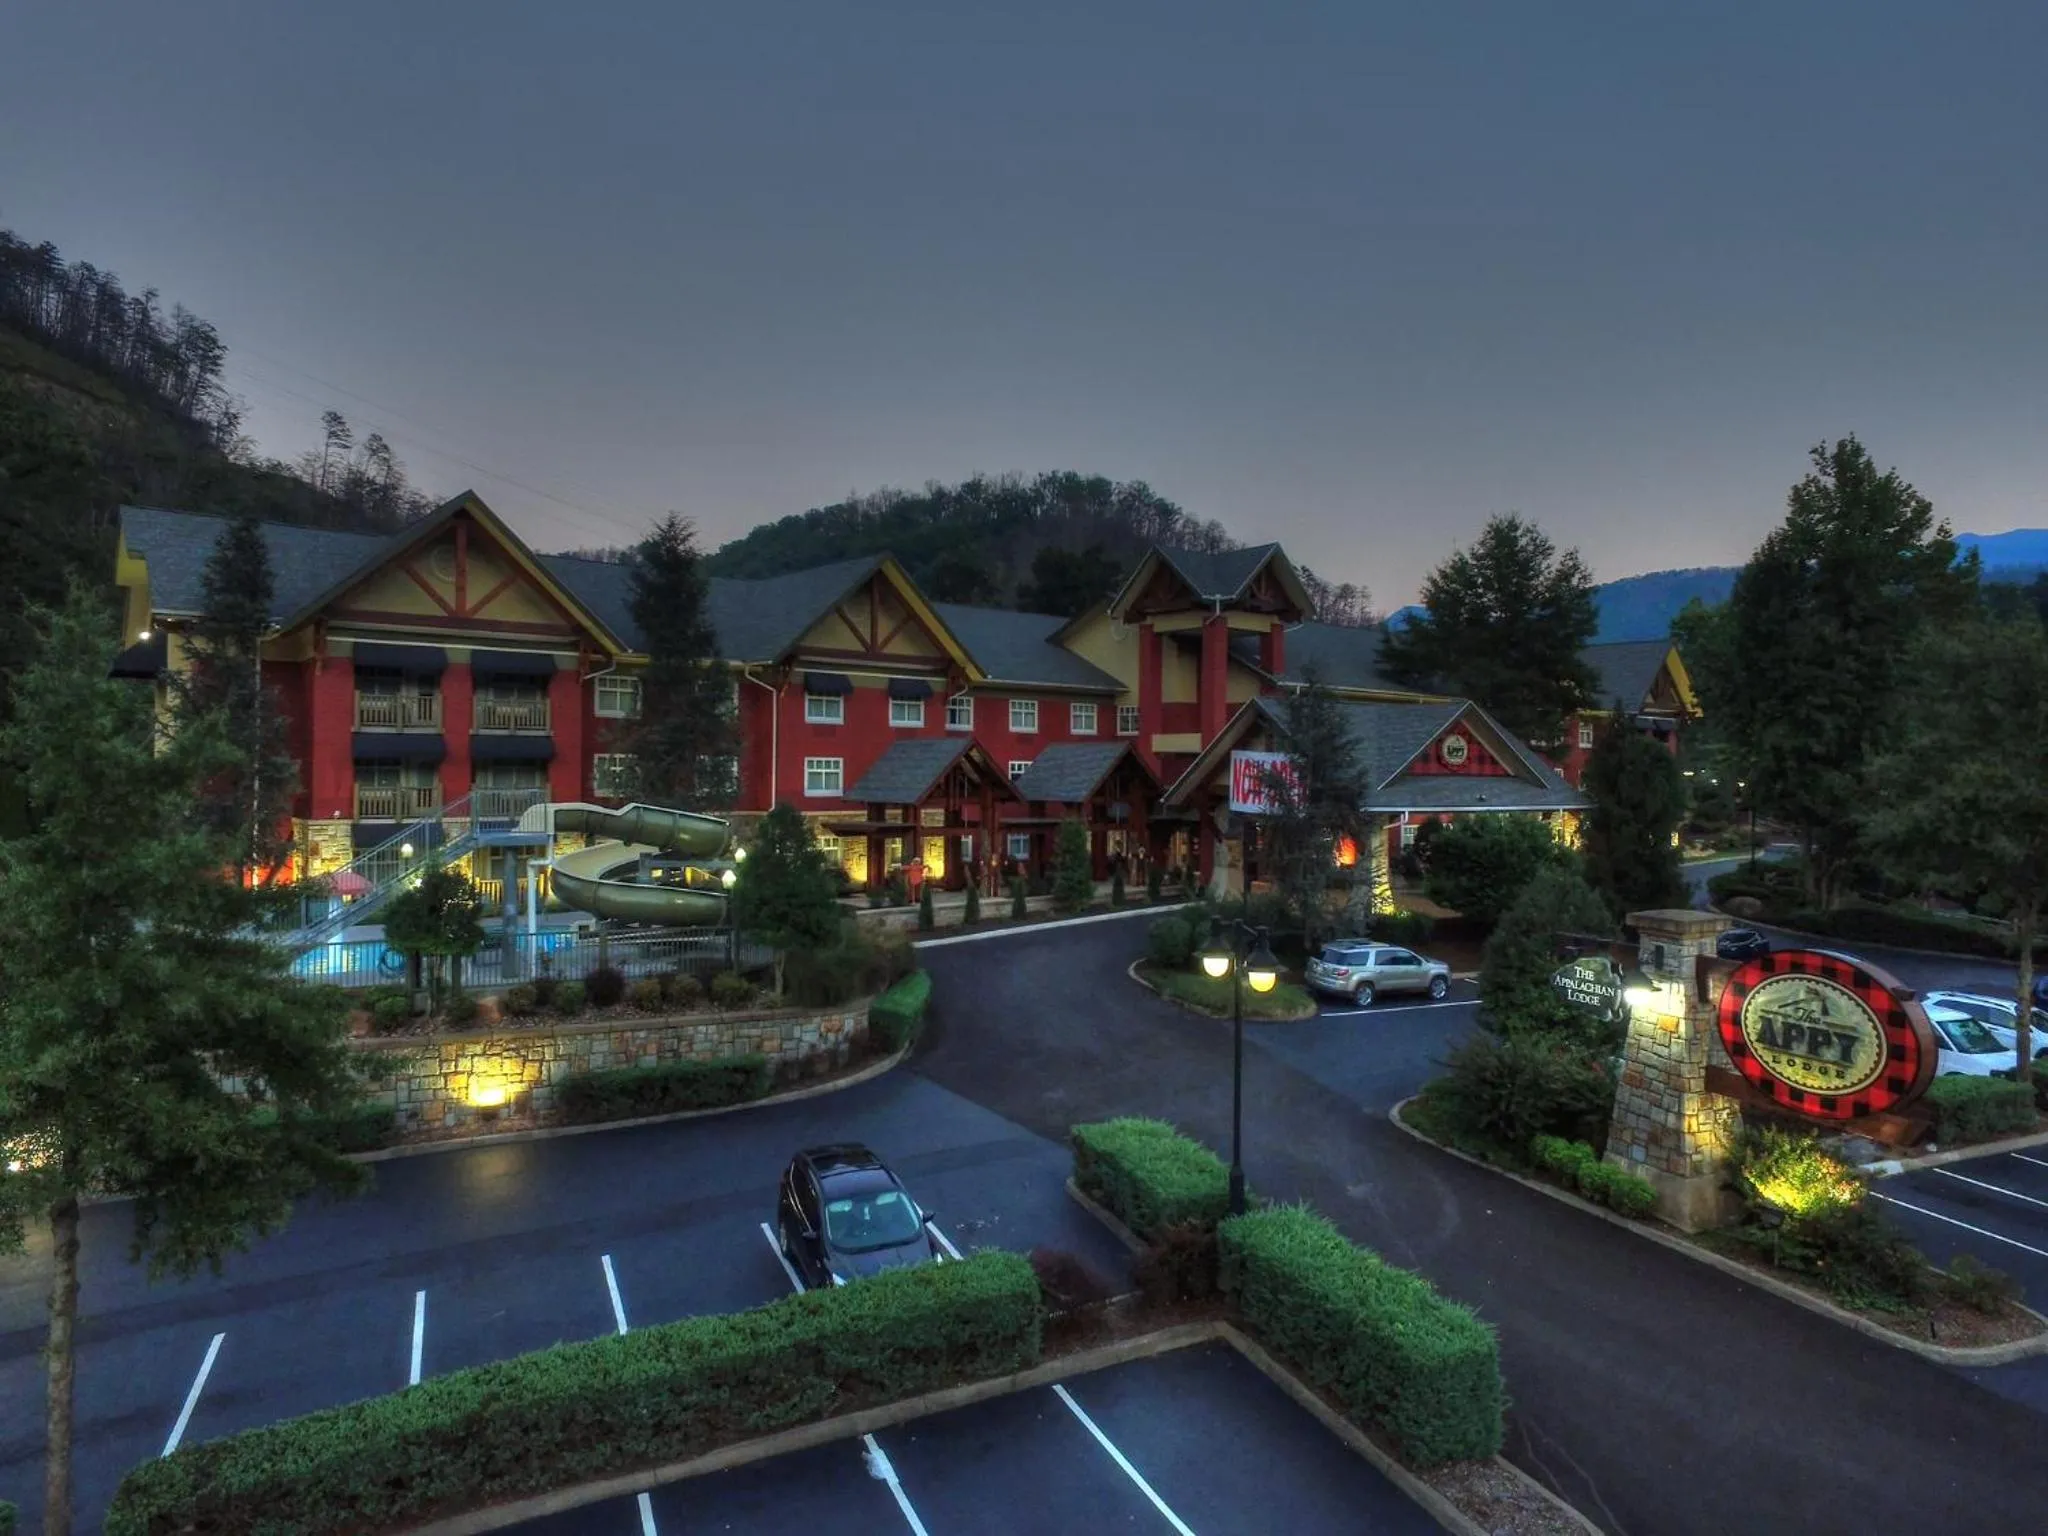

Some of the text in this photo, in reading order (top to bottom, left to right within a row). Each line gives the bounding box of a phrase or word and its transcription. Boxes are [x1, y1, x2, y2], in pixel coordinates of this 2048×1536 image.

[1574, 966, 1595, 981] THE
[1554, 974, 1616, 997] APPALACHIAN
[1567, 989, 1601, 1007] LODGE
[1795, 1006, 1821, 1025] The
[1756, 1014, 1859, 1067] APPY
[1771, 1054, 1846, 1080] LODGE
